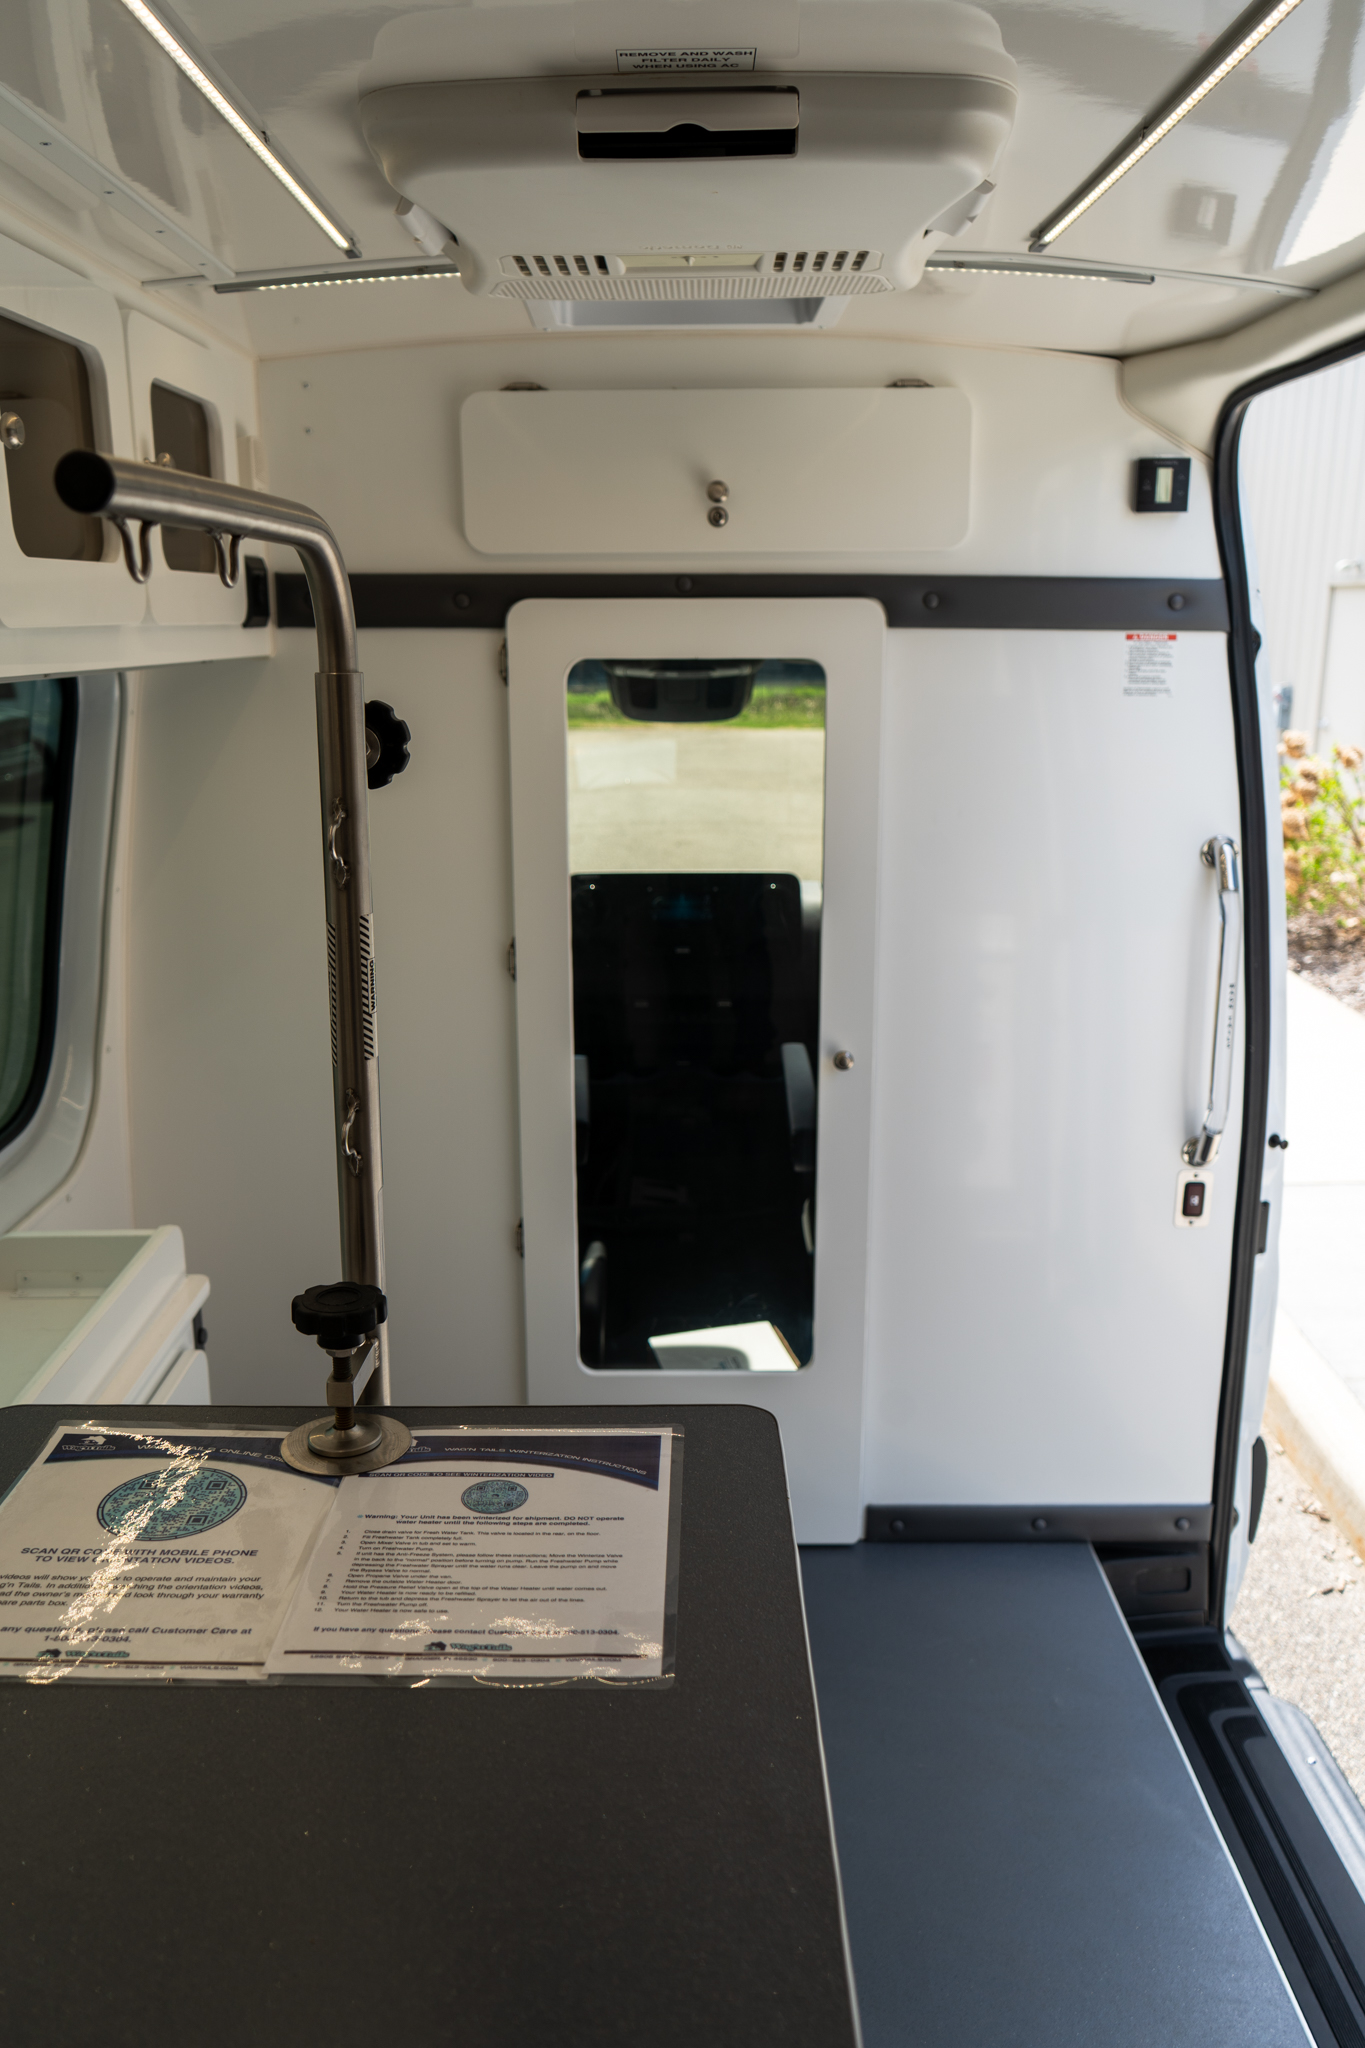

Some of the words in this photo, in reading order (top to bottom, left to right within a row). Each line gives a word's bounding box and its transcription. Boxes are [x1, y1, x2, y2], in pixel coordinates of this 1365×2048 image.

[220, 1448, 262, 1457] ONLINE
[509, 1449, 580, 1460] WINTERIZATION
[582, 1457, 647, 1475] INSTRUCTIONS
